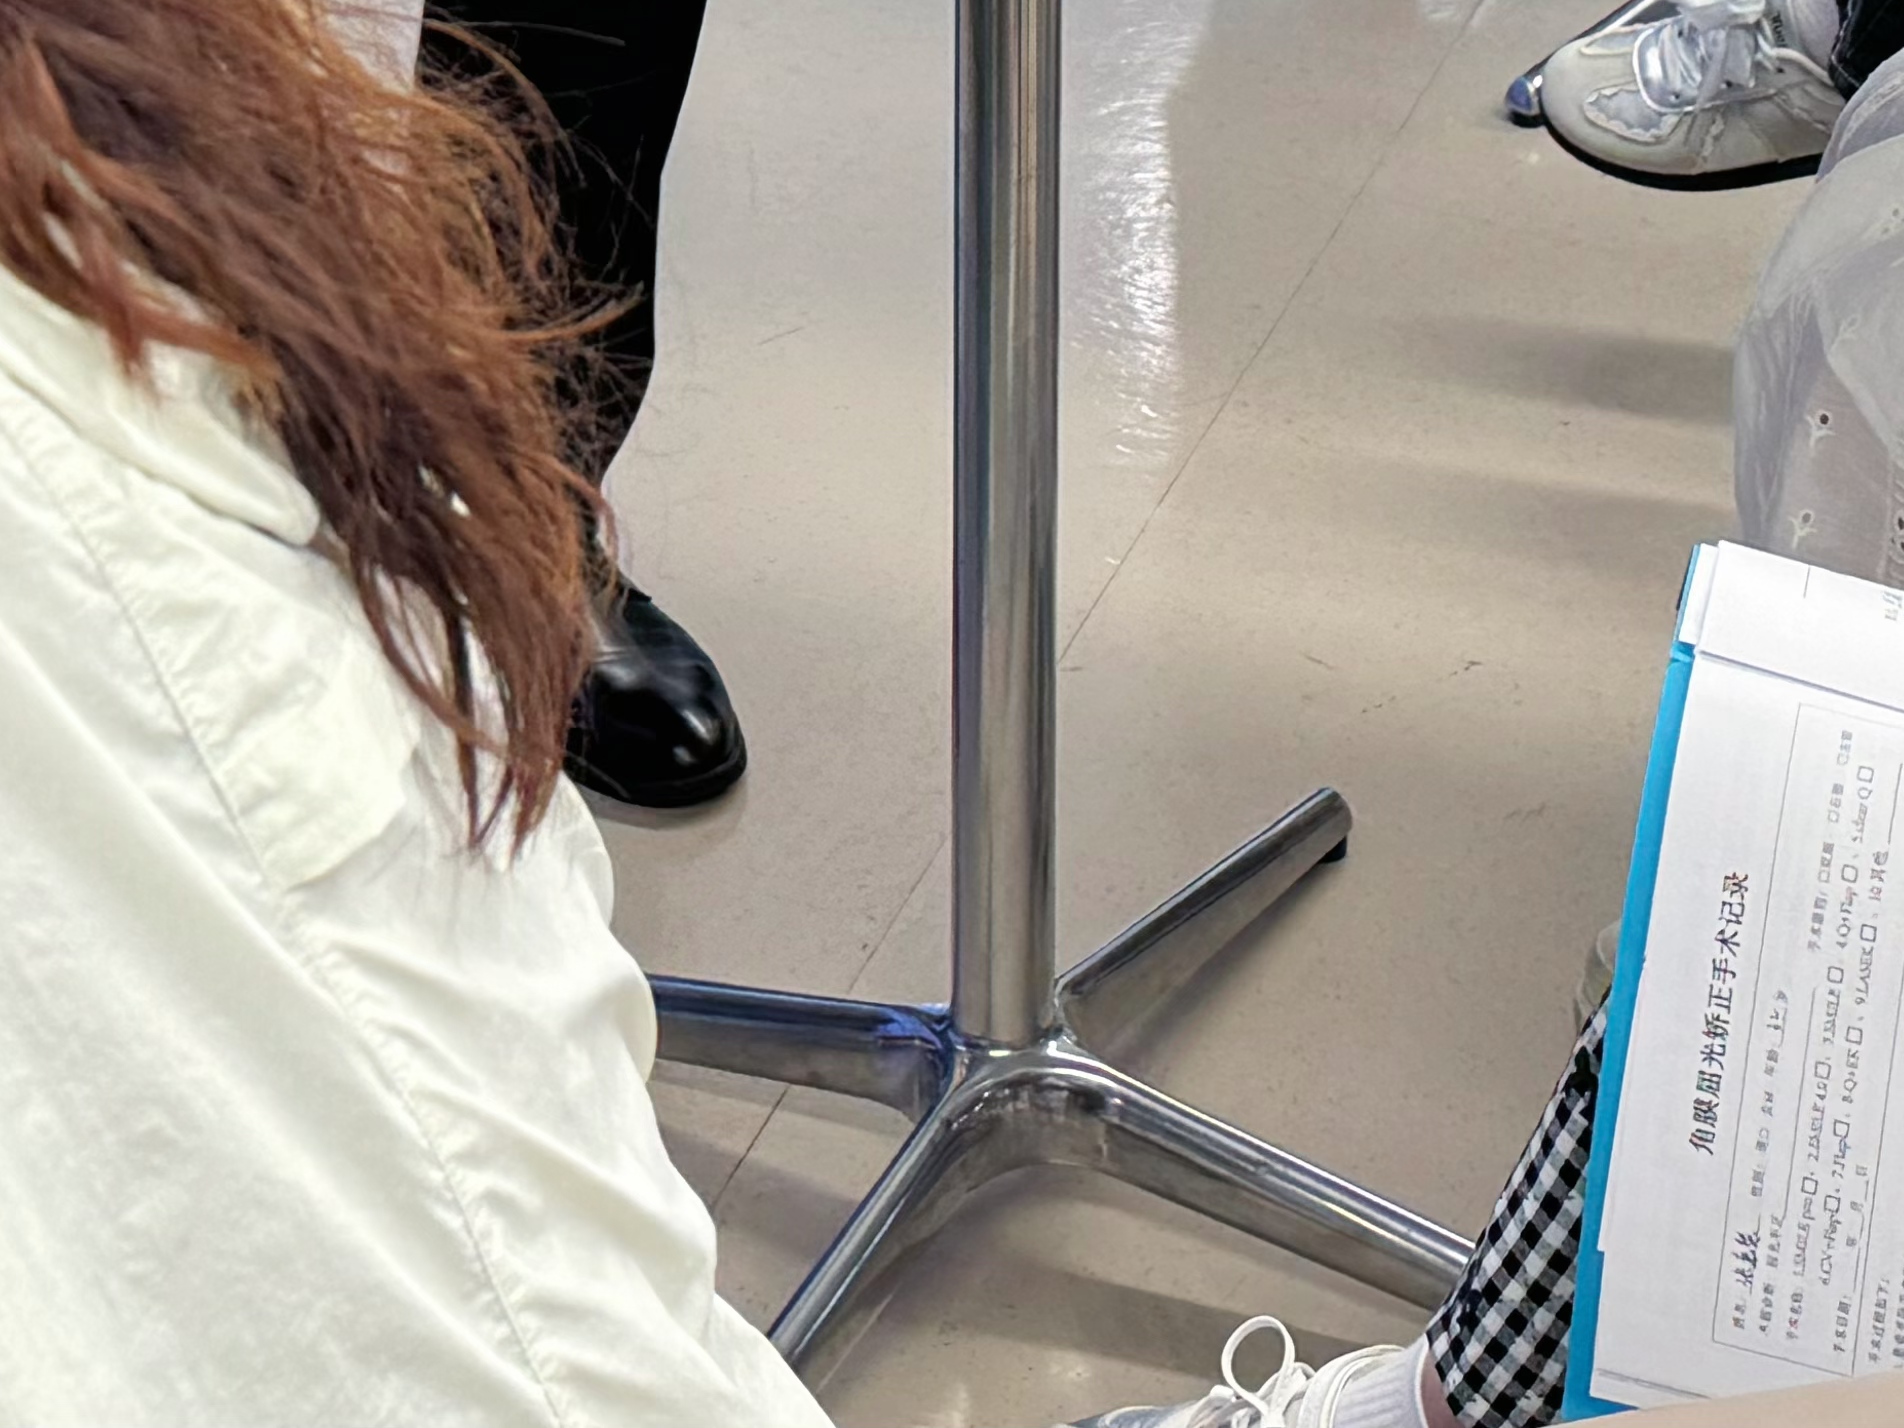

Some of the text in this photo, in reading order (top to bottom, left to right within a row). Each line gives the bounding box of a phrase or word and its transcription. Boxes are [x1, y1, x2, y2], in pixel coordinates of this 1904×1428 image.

[1686, 870, 1749, 1155] 角膜屈光矫正手术记录
